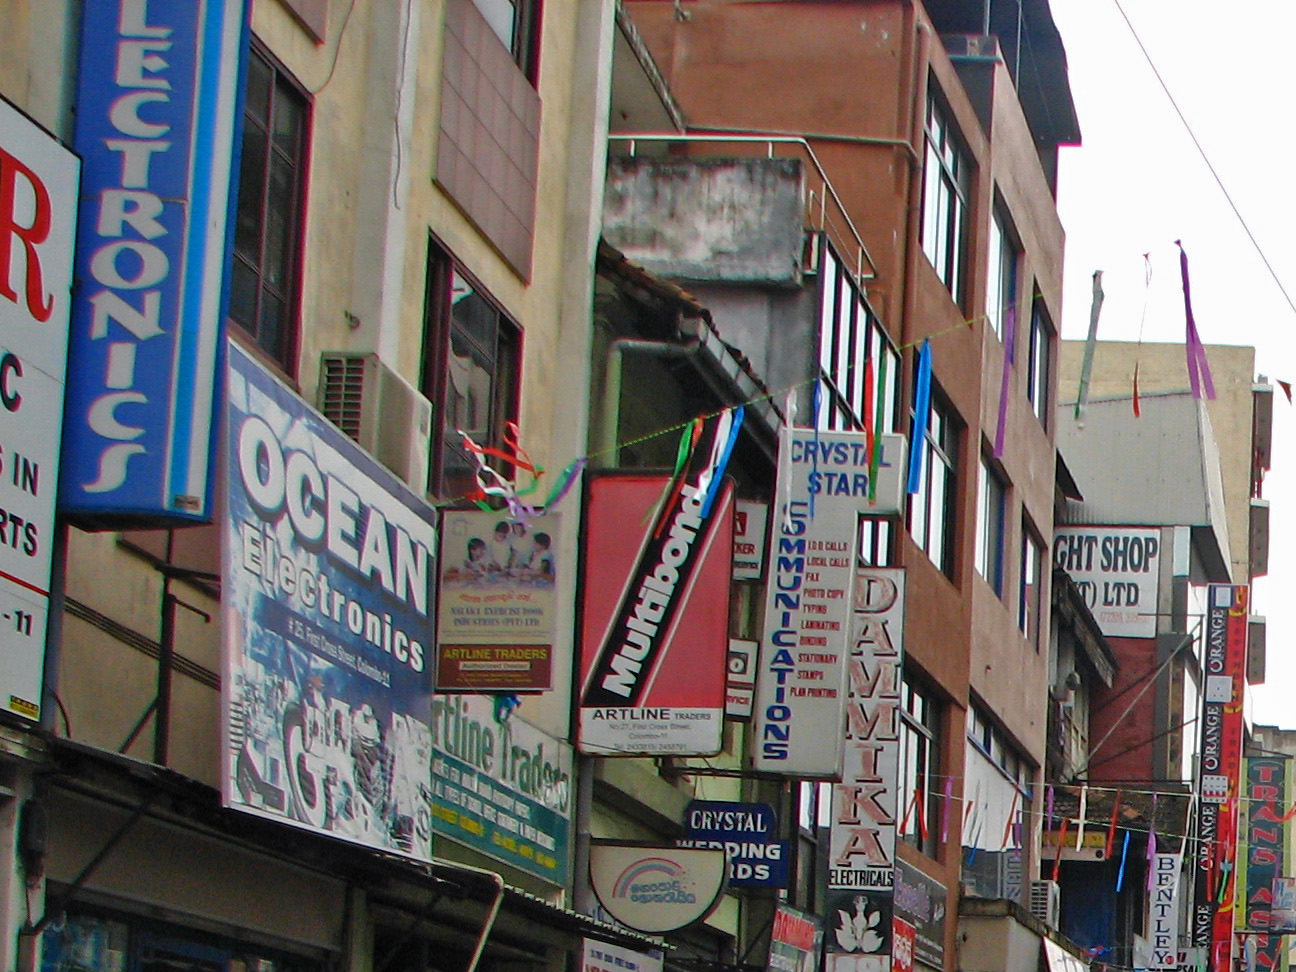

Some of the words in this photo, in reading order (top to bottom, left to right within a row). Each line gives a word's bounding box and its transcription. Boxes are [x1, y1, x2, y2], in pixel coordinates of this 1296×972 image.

[807, 471, 869, 497] STAR
[239, 416, 428, 619] OCEAN
[1101, 535, 1158, 573] SHOP
[243, 520, 425, 673] Electronics
[602, 484, 706, 698] Multibond
[1103, 581, 1140, 608] LTD
[444, 648, 492, 659] ARTLINE
[495, 648, 548, 660] TRADERS
[1210, 609, 1225, 673] ORANGE
[593, 708, 671, 720] ARTLINE
[1203, 705, 1219, 771] ORANGE
[690, 810, 768, 833] CRYSTAL
[829, 869, 894, 887] ELECTRICALS
[1154, 857, 1175, 965] BENTLEY
